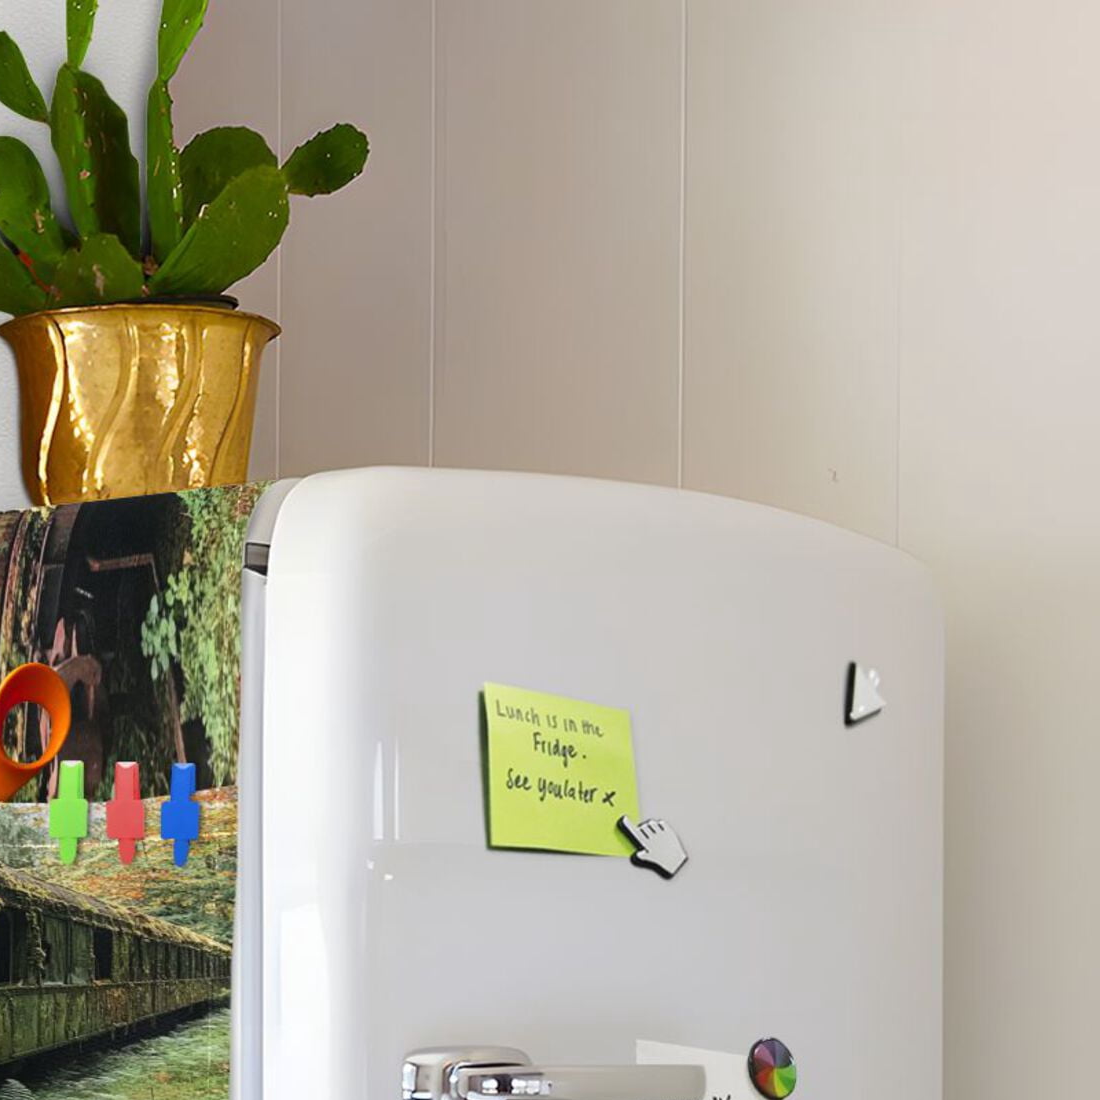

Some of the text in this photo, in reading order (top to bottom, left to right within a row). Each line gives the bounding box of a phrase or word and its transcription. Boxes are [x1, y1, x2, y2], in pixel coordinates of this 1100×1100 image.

[495, 698, 604, 737] Lunch is in the
[506, 768, 532, 790] See
